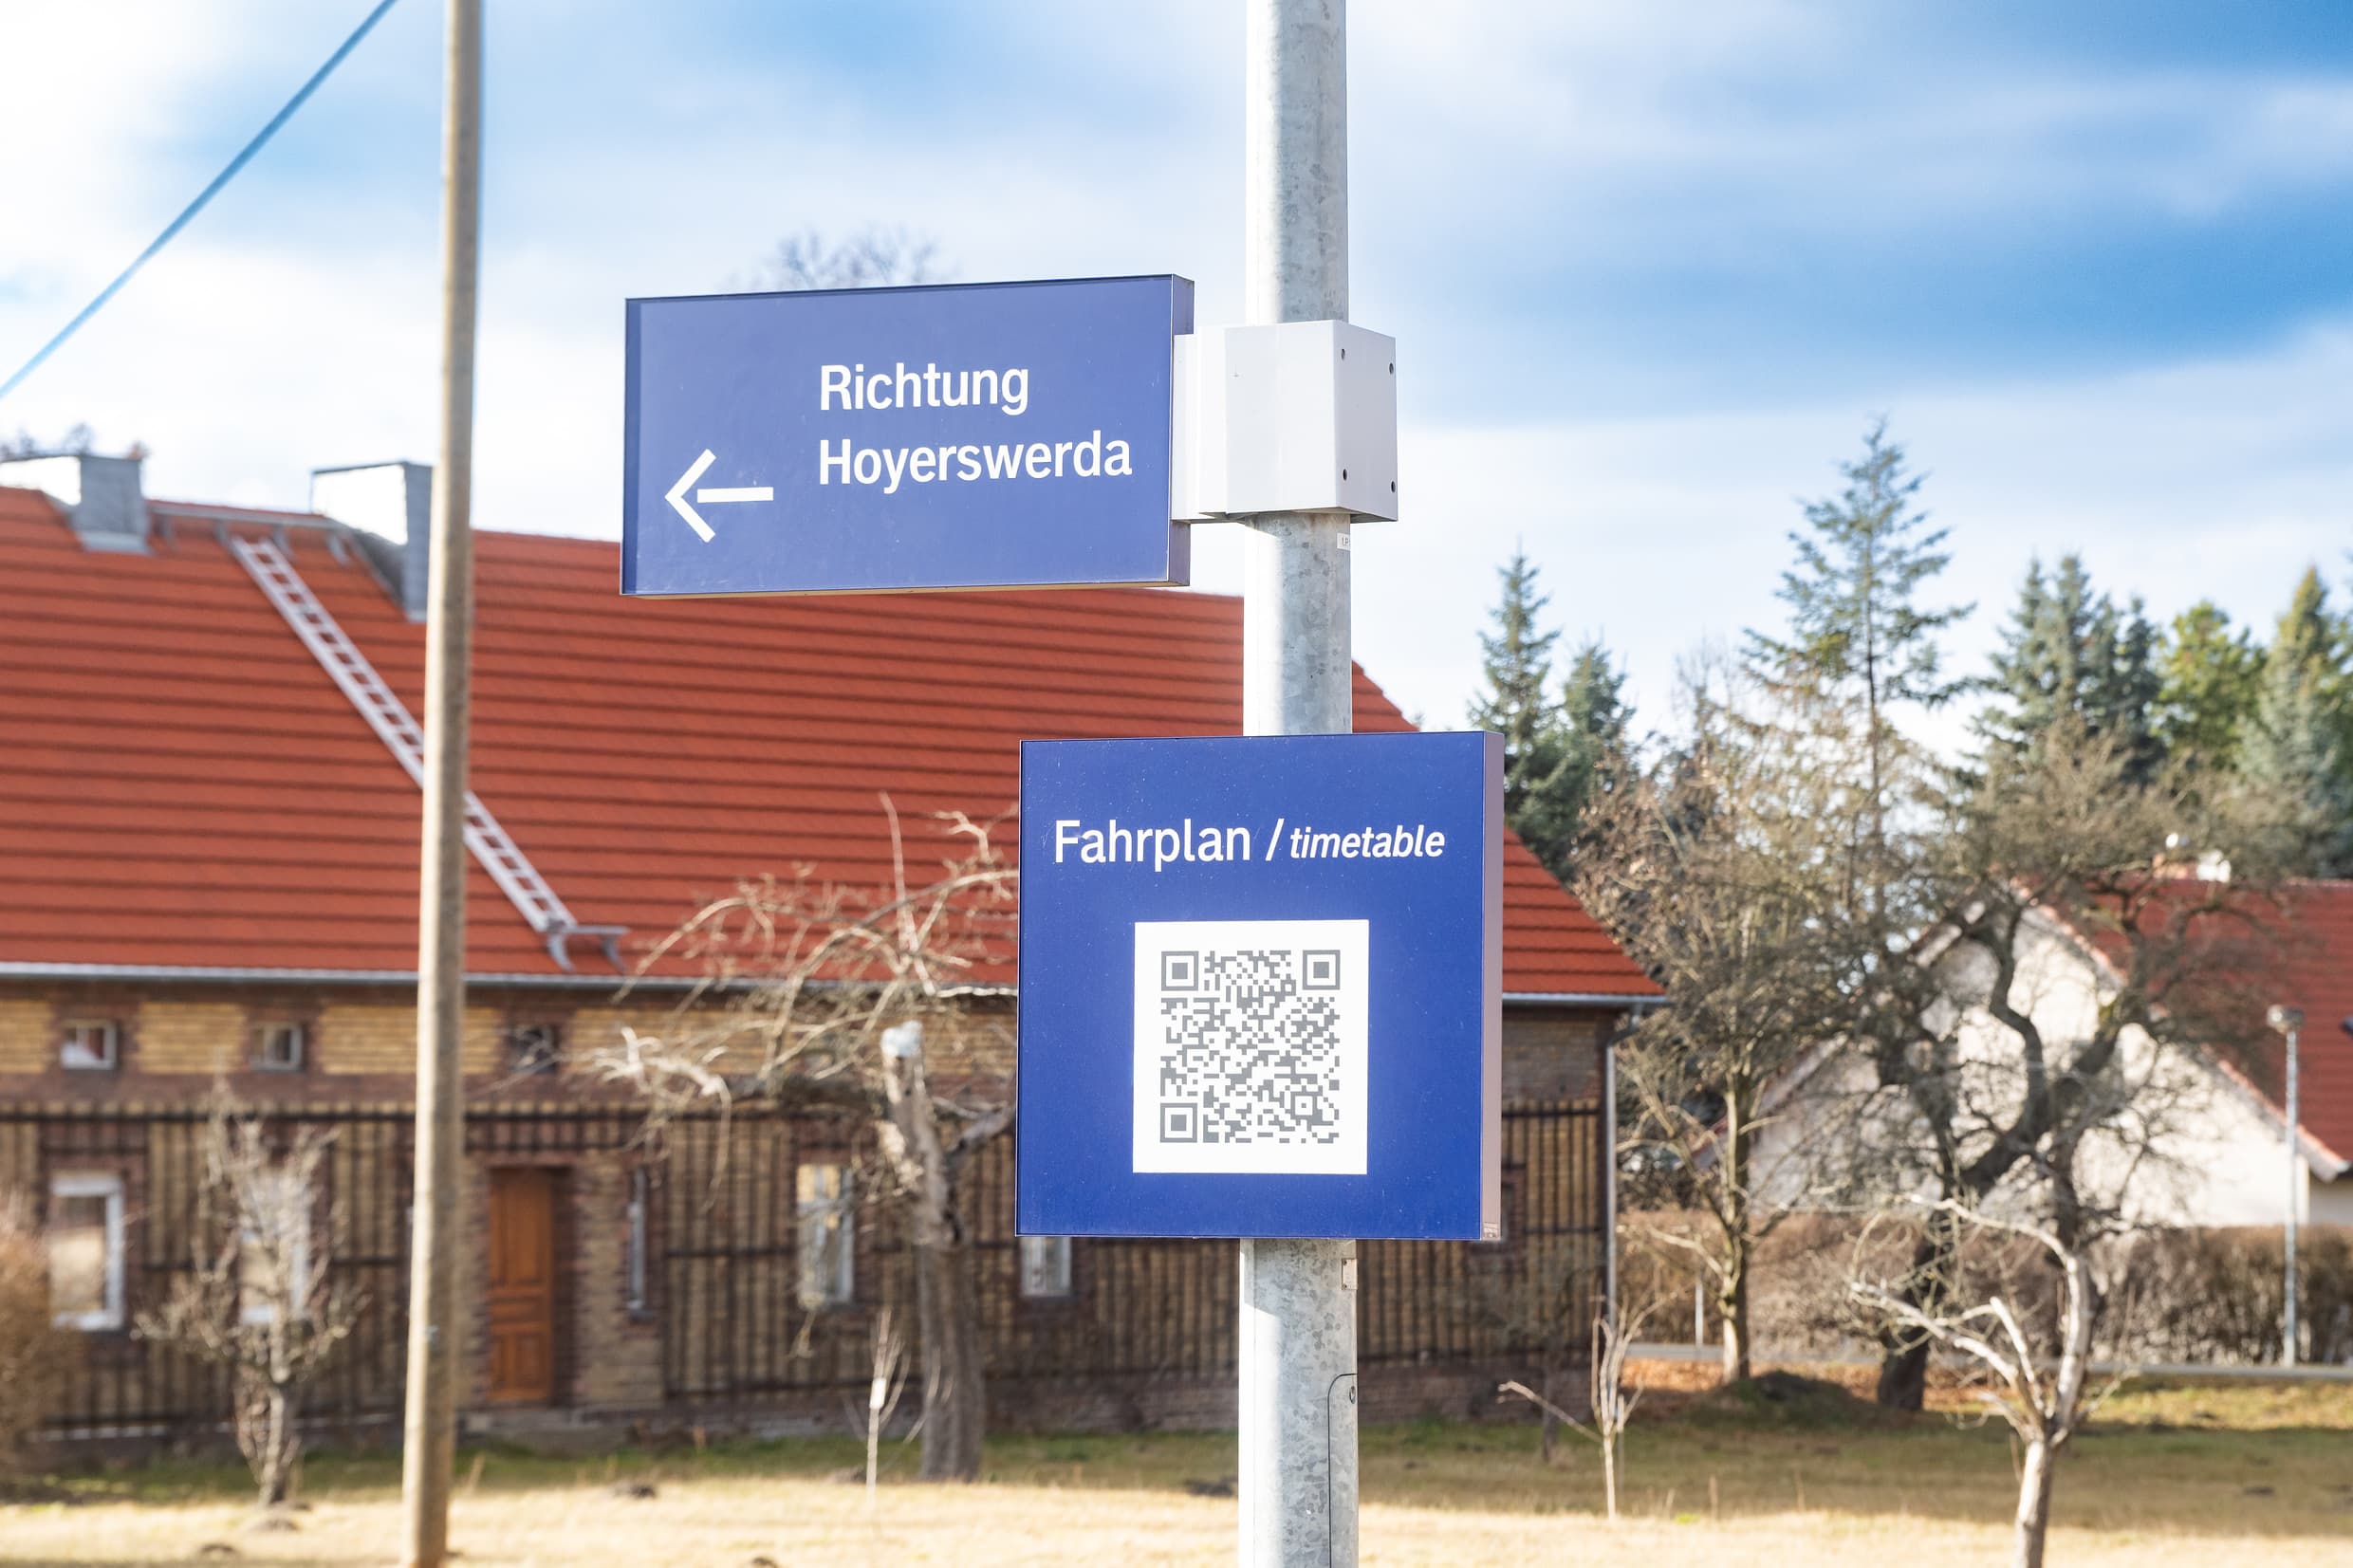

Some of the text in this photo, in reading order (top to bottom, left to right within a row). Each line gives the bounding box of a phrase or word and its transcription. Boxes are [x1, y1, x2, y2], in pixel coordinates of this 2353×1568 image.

[819, 362, 1028, 415] Richtung
[819, 430, 1133, 494] Hoyerswerda
[1055, 819, 1251, 872] Fahrplan
